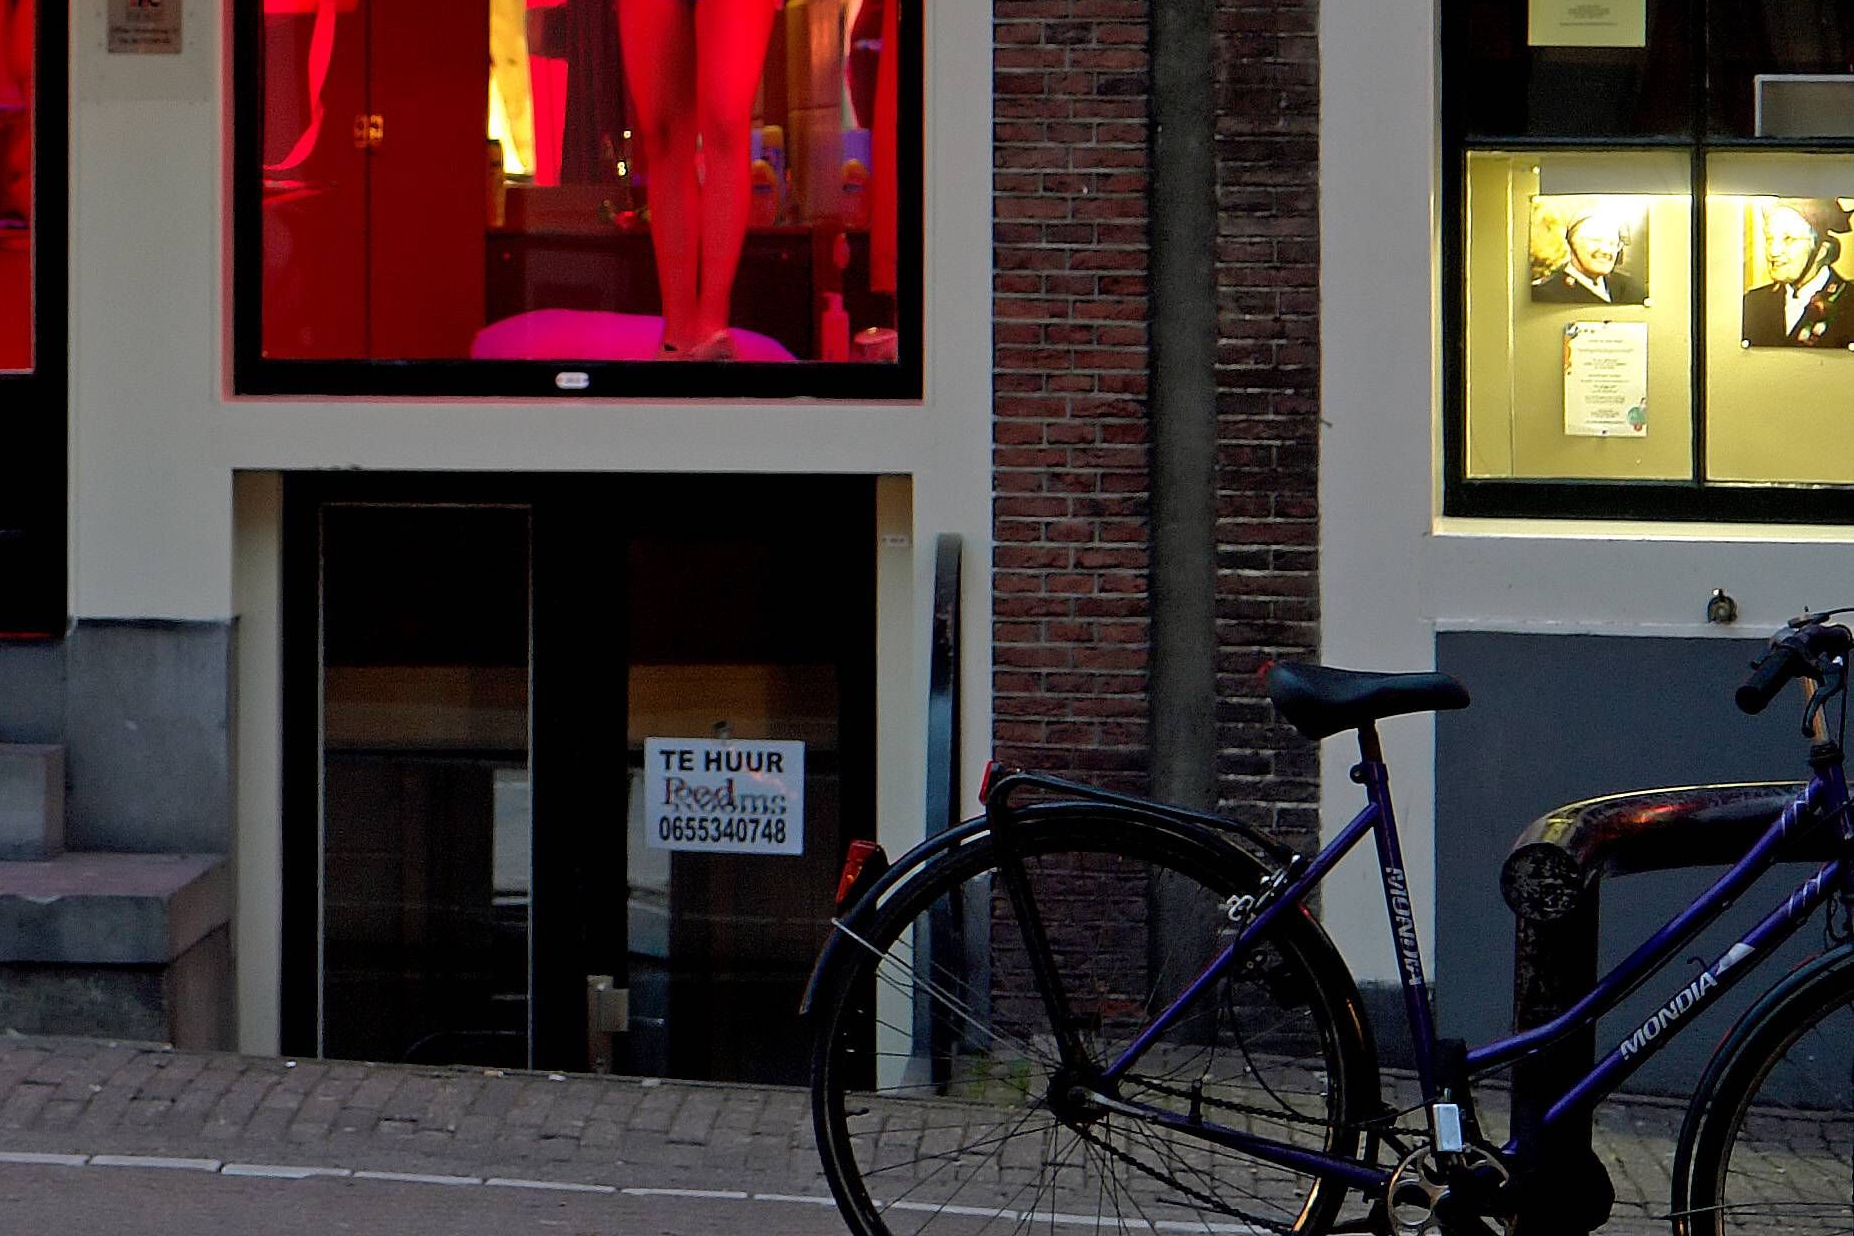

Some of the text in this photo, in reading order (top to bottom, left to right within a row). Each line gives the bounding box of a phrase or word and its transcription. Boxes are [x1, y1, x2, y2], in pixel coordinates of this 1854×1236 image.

[659, 749, 784, 773] TE HUUR
[659, 816, 786, 844] 0655340748
[1385, 866, 1423, 986] MONDIA
[1620, 971, 1718, 1061] MONDIA
